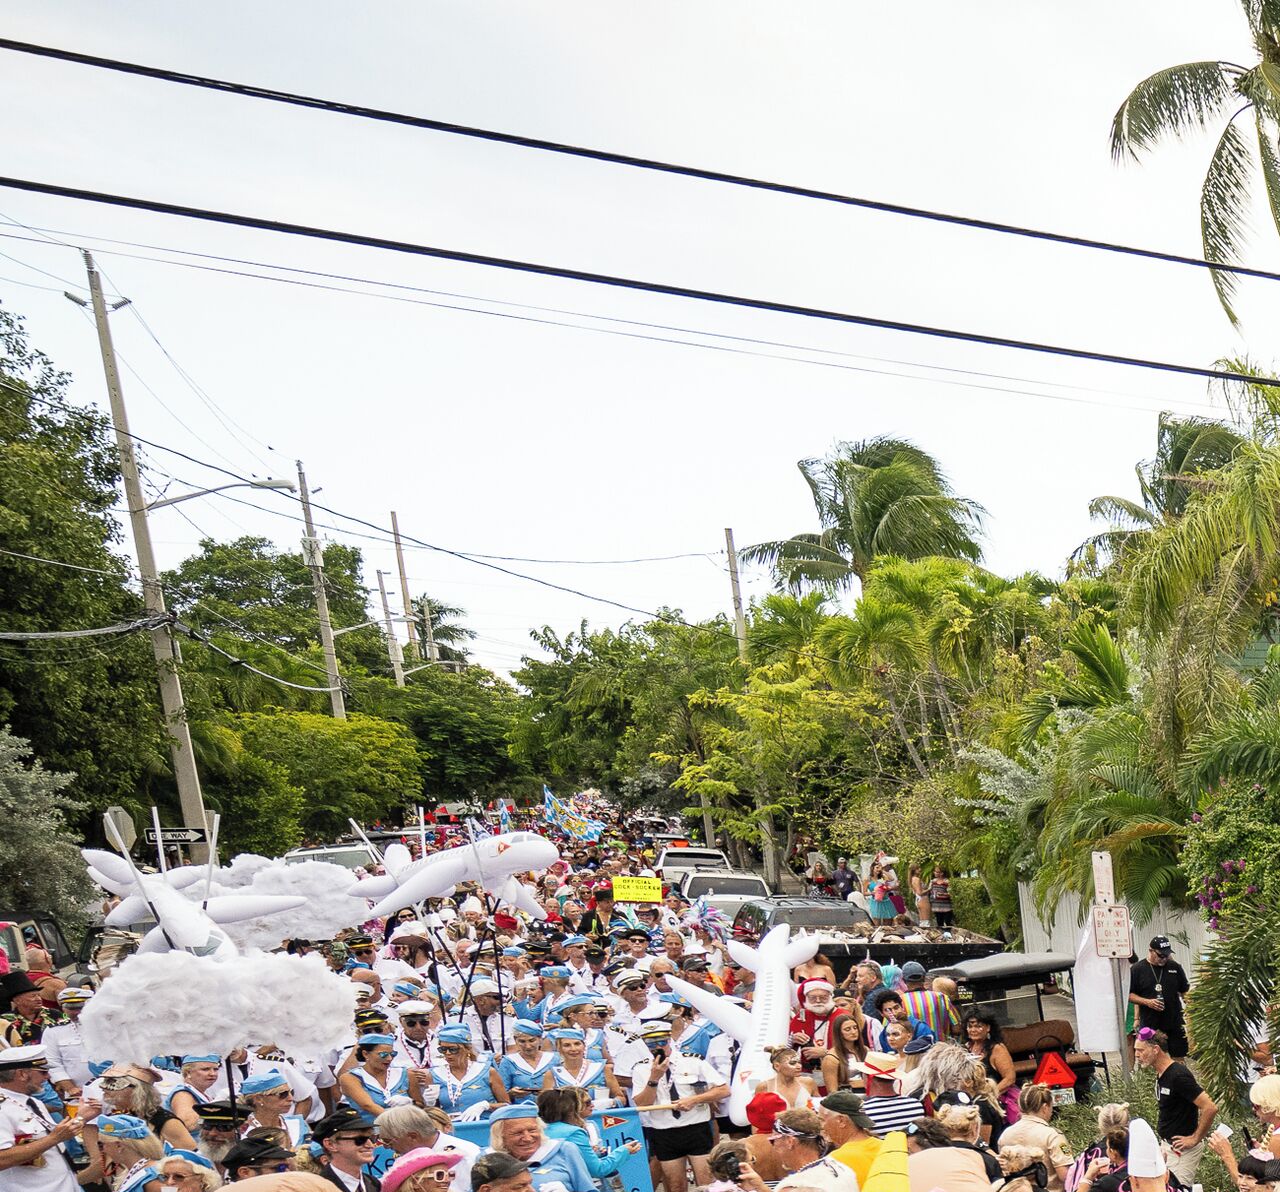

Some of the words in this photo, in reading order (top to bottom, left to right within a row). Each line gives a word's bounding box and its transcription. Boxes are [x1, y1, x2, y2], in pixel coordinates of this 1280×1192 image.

[151, 831, 168, 840] OE
[171, 831, 187, 839] WAY
[1097, 911, 1123, 919] PANG
[1097, 920, 1104, 928] BY
